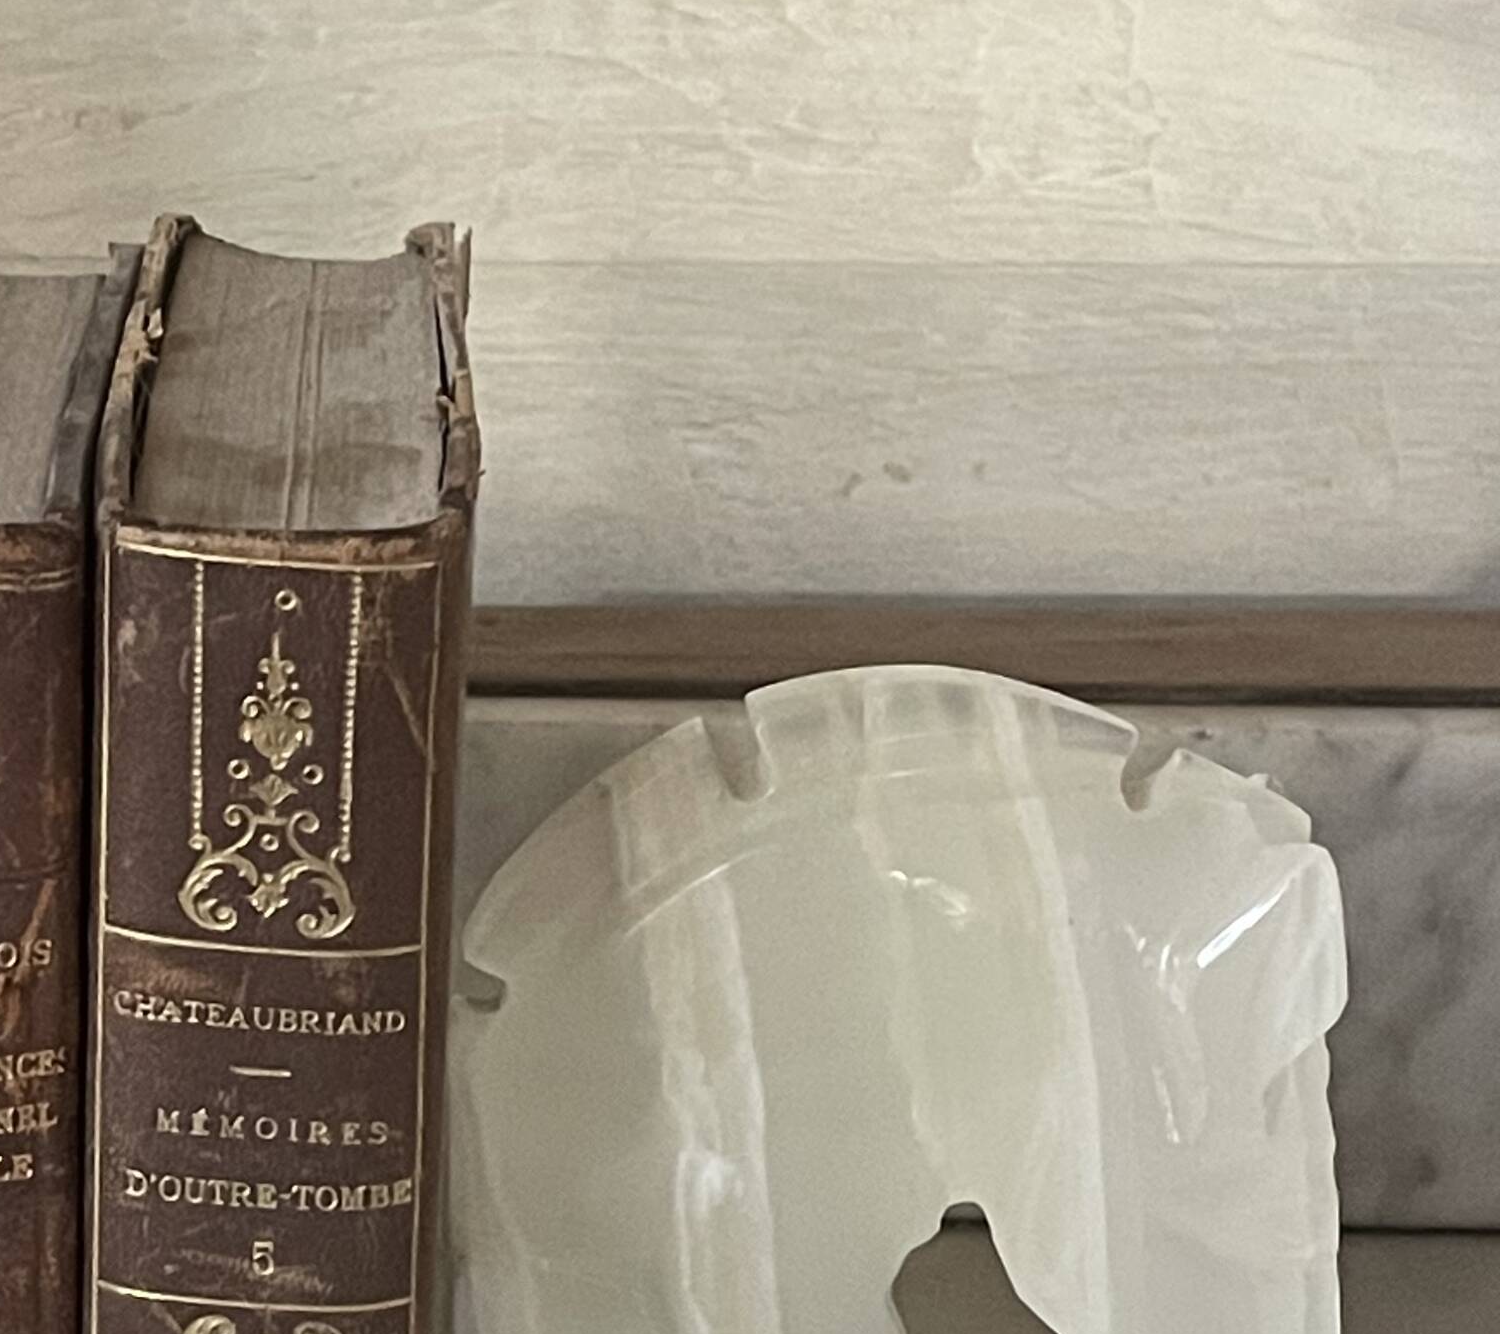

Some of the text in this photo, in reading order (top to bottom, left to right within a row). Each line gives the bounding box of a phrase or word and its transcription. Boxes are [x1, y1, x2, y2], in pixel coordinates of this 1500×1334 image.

[112, 989, 407, 1037] CHATEAUBRIAND
[124, 1168, 413, 1213] D'OUTRE-TOMBE
[251, 1240, 275, 1276] 5
